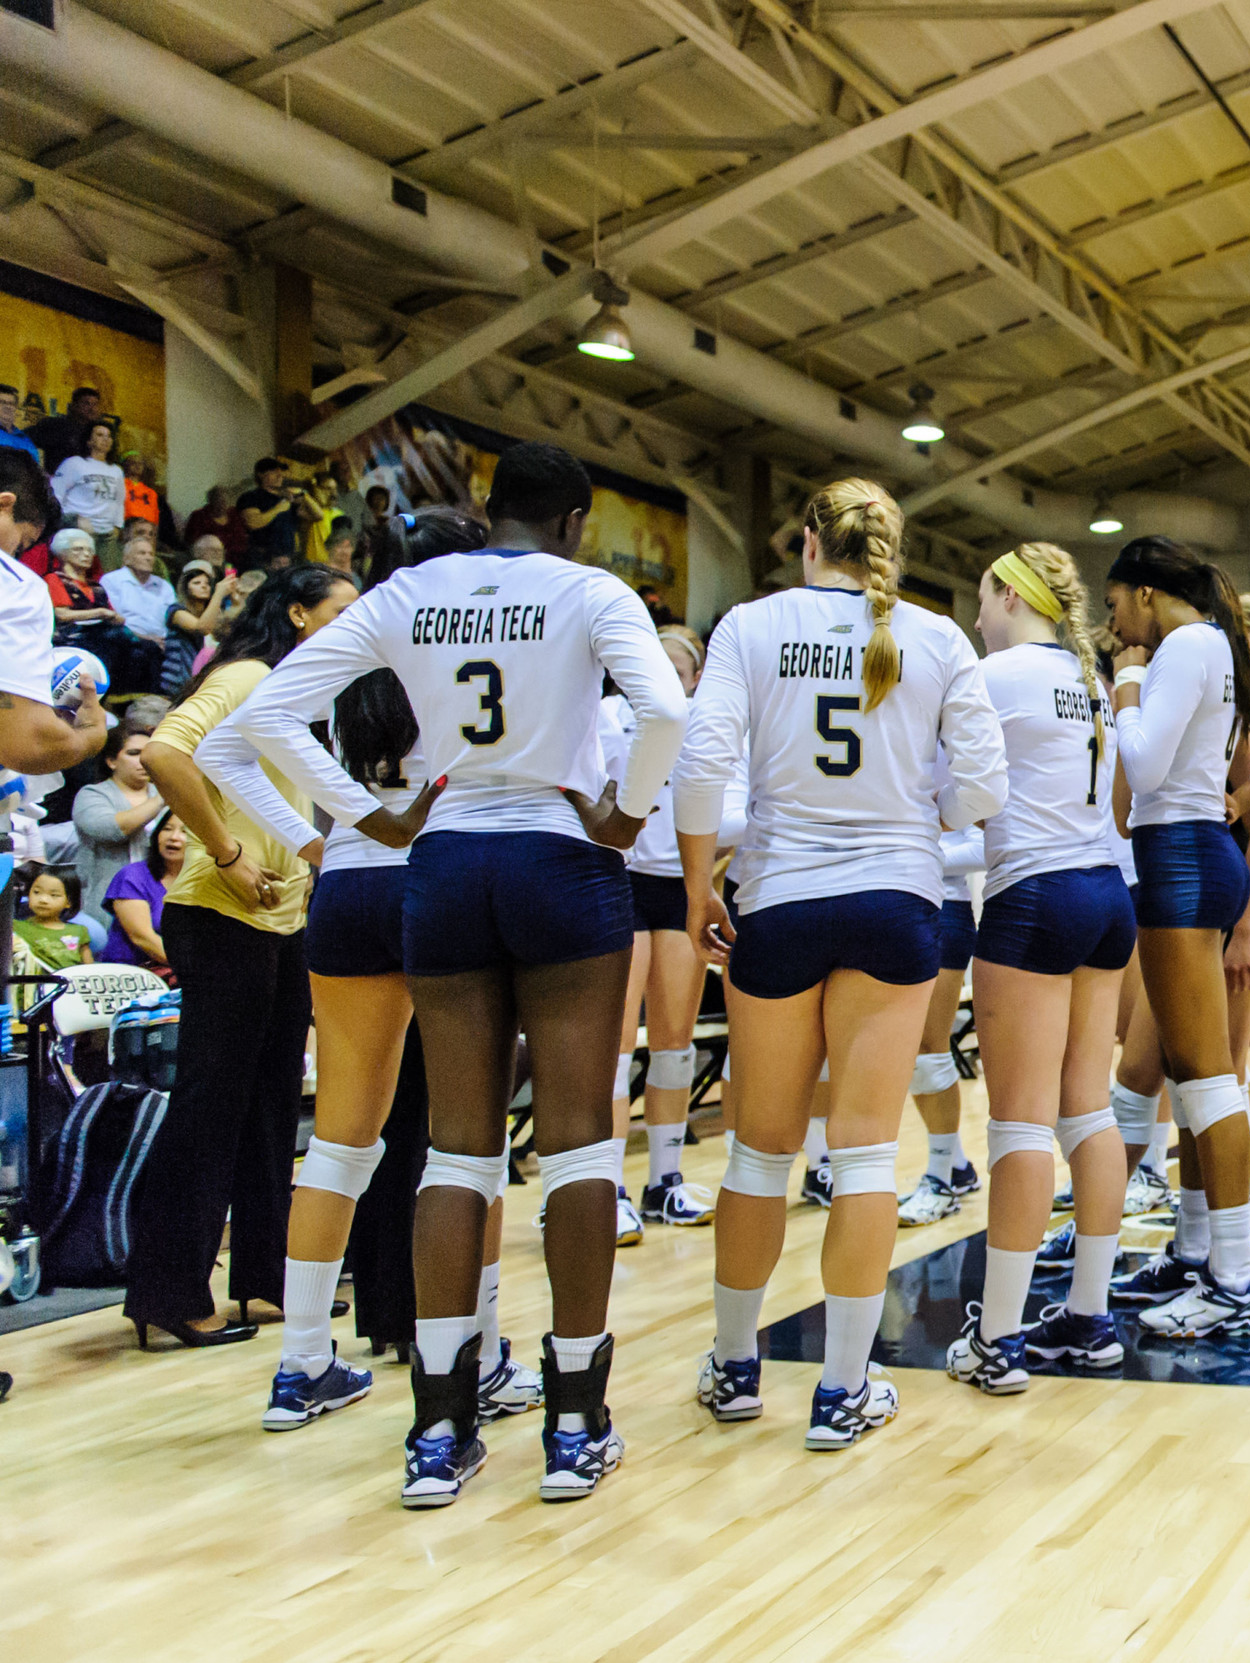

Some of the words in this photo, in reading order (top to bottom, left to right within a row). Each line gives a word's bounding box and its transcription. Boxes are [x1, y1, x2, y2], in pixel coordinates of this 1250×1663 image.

[412, 607, 494, 645] GEORGIA
[500, 605, 547, 642] TECH
[779, 642, 853, 680] GEORGIA
[454, 658, 506, 748] 3
[814, 693, 863, 779] 5
[1087, 734, 1099, 807] 1
[82, 991, 148, 1014] TEC
